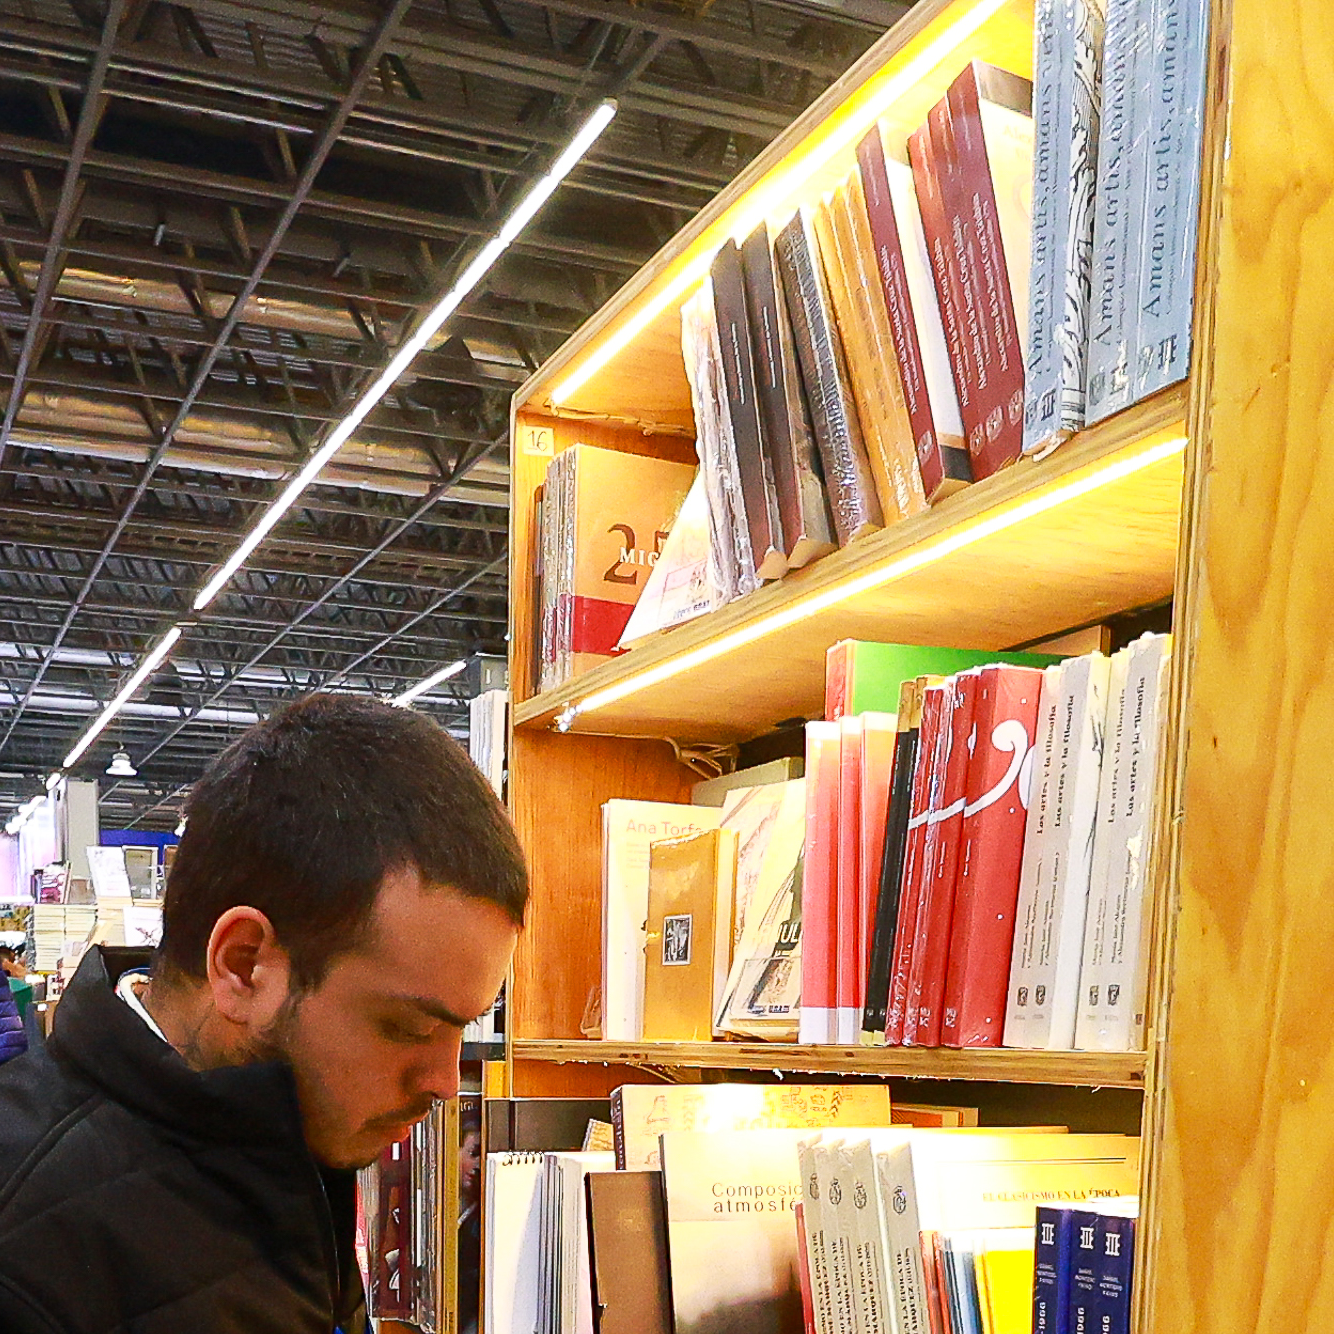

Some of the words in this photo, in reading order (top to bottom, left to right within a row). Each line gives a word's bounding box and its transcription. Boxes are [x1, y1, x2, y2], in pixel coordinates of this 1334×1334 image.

[1092, 236, 1118, 345] Amans
[1141, 203, 1168, 316] Amans
[1027, 272, 1047, 376] Amans
[528, 430, 547, 450] 16
[626, 819, 657, 835] Ana
